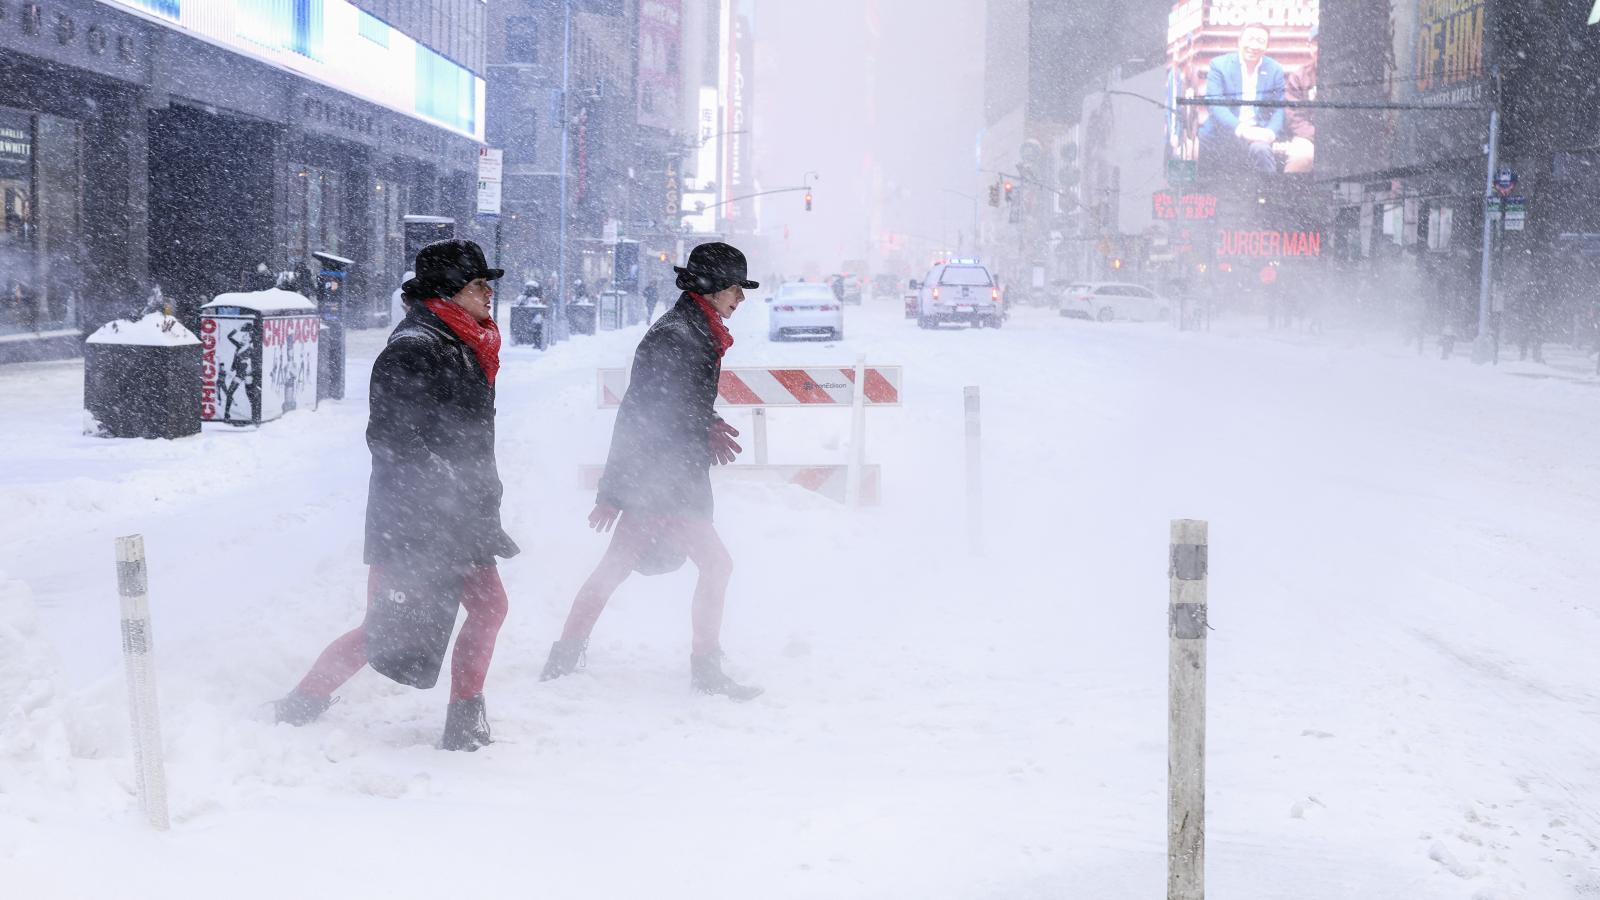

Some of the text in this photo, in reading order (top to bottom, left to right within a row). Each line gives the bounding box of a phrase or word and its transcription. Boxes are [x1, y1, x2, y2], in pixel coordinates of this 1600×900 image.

[1416, 6, 1485, 92] OF HIM
[1283, 230, 1321, 257] MAN
[262, 318, 319, 347] CHICAGO
[201, 318, 217, 420] CHICAGO
